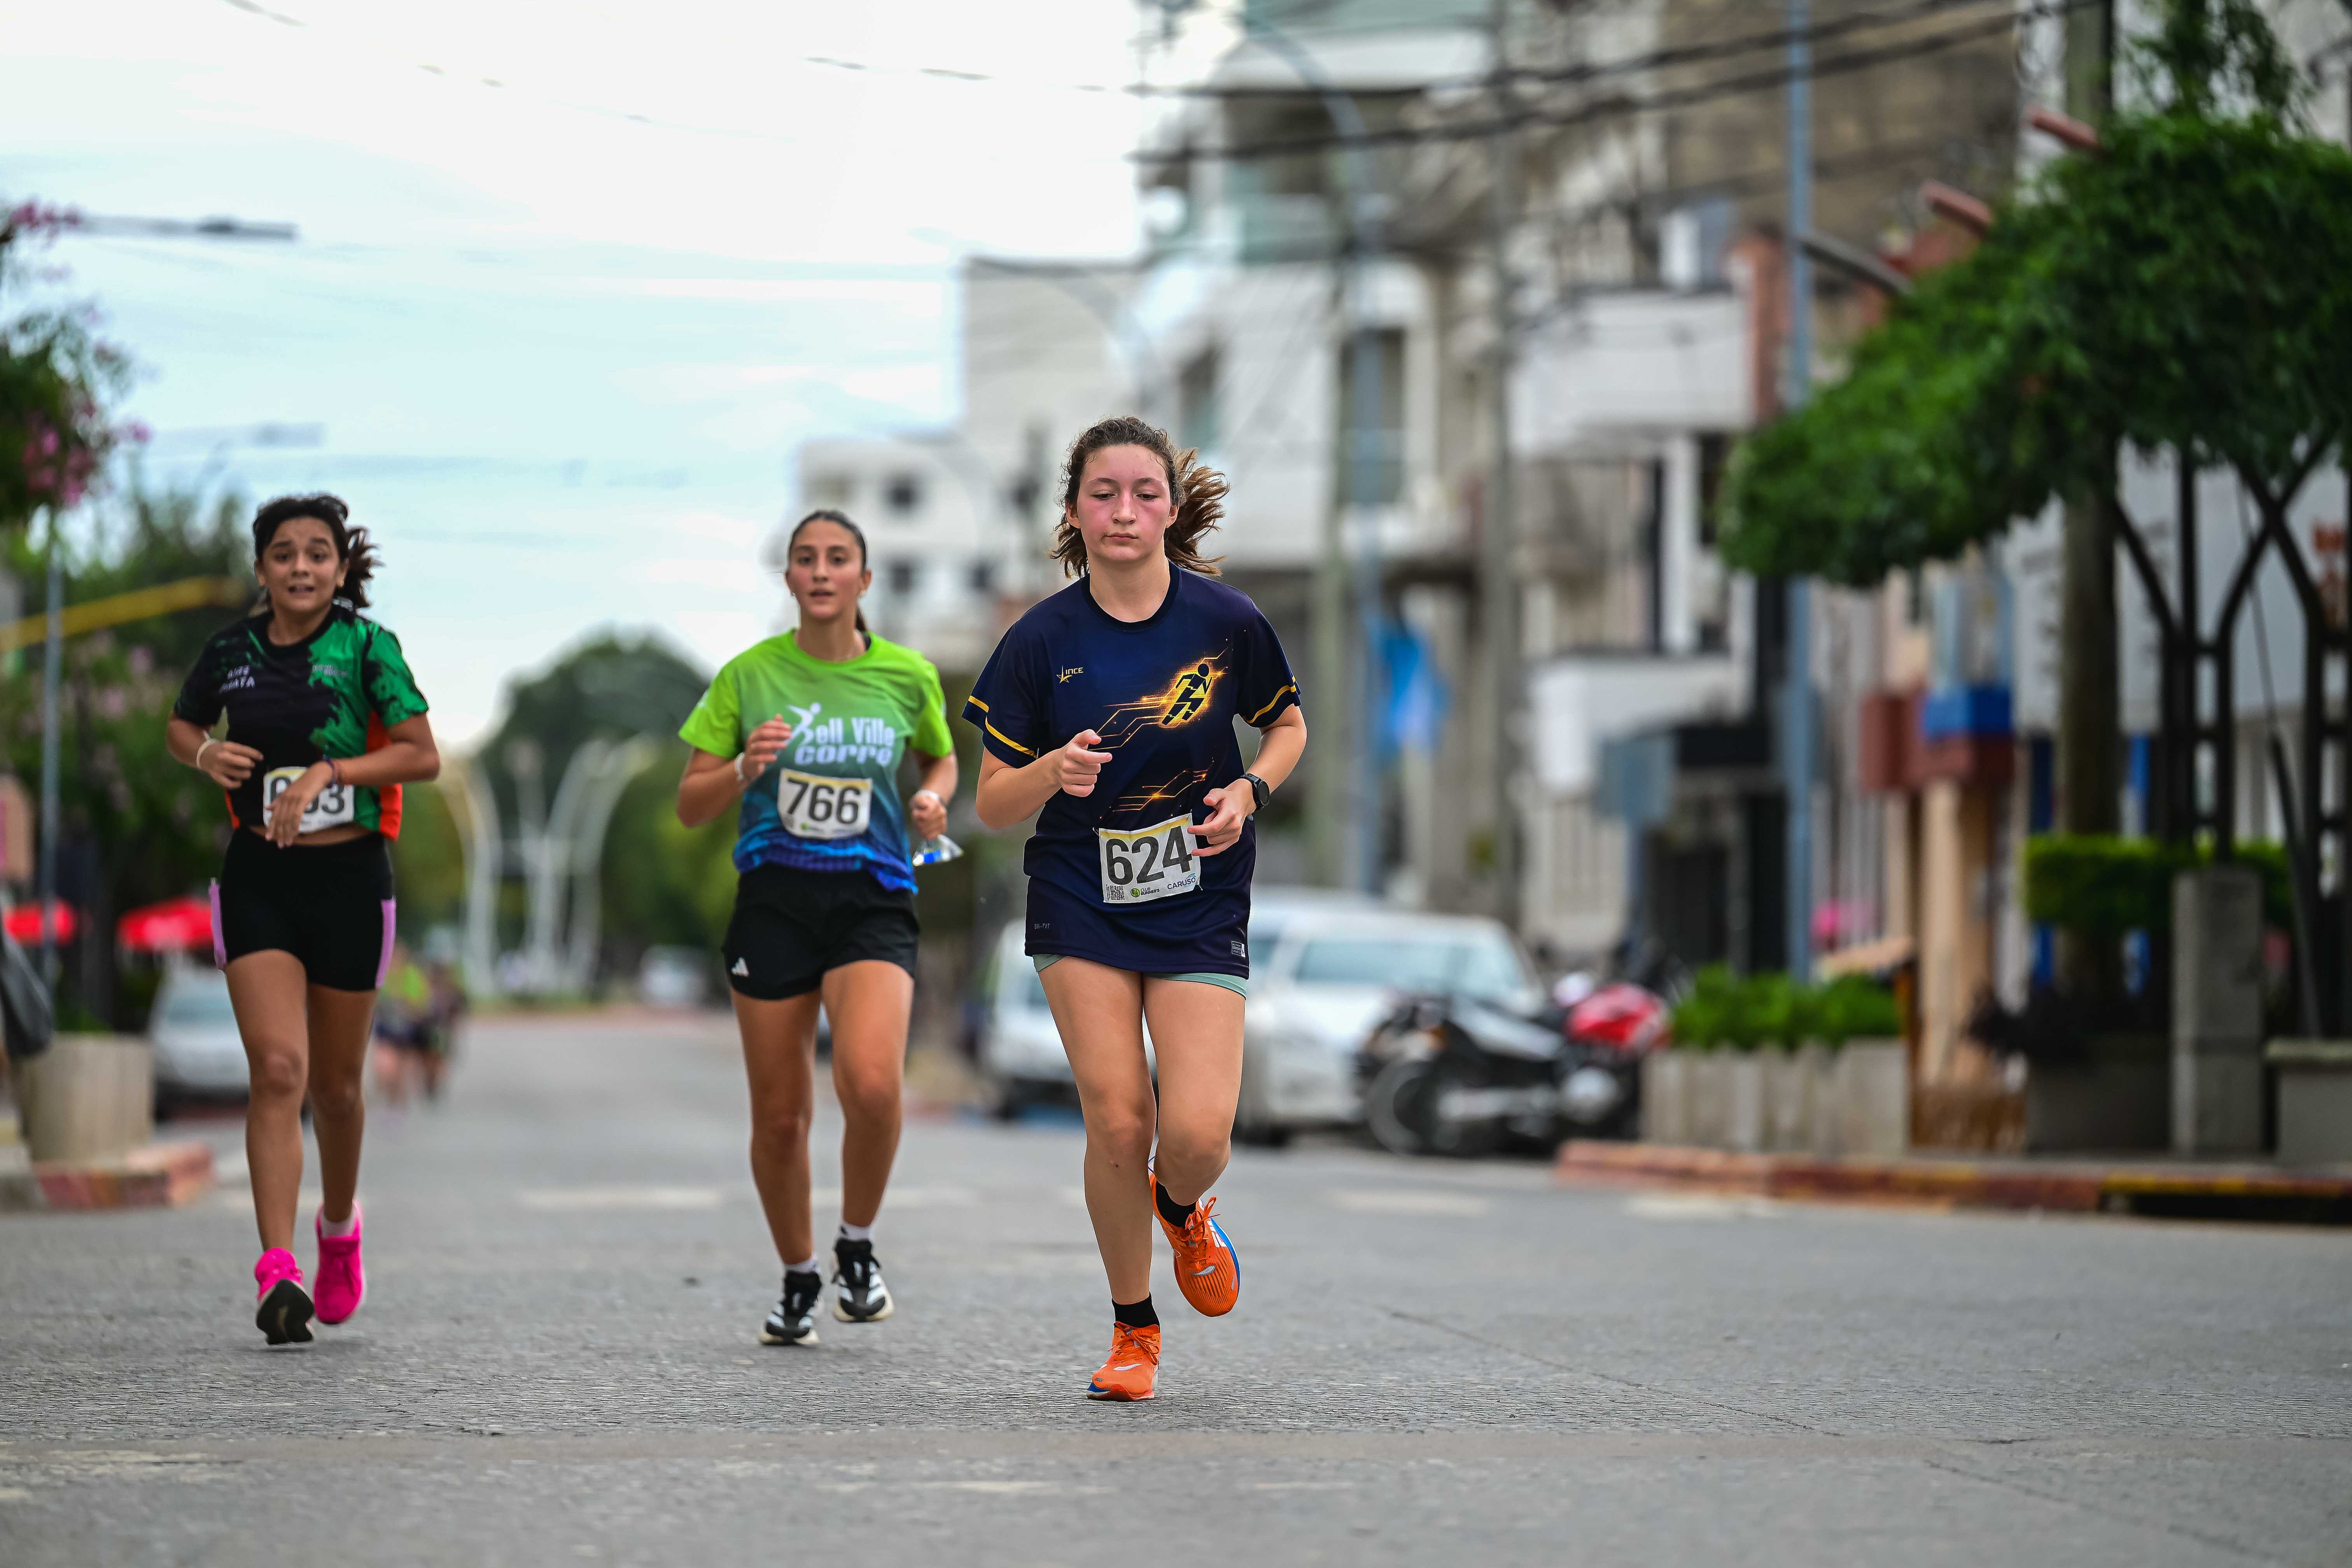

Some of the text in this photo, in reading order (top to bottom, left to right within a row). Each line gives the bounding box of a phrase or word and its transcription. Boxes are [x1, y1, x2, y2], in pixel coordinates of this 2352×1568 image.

[787, 777, 861, 824] 766
[1106, 825, 1193, 885] 624
[1167, 877, 1196, 890] CARUSO
